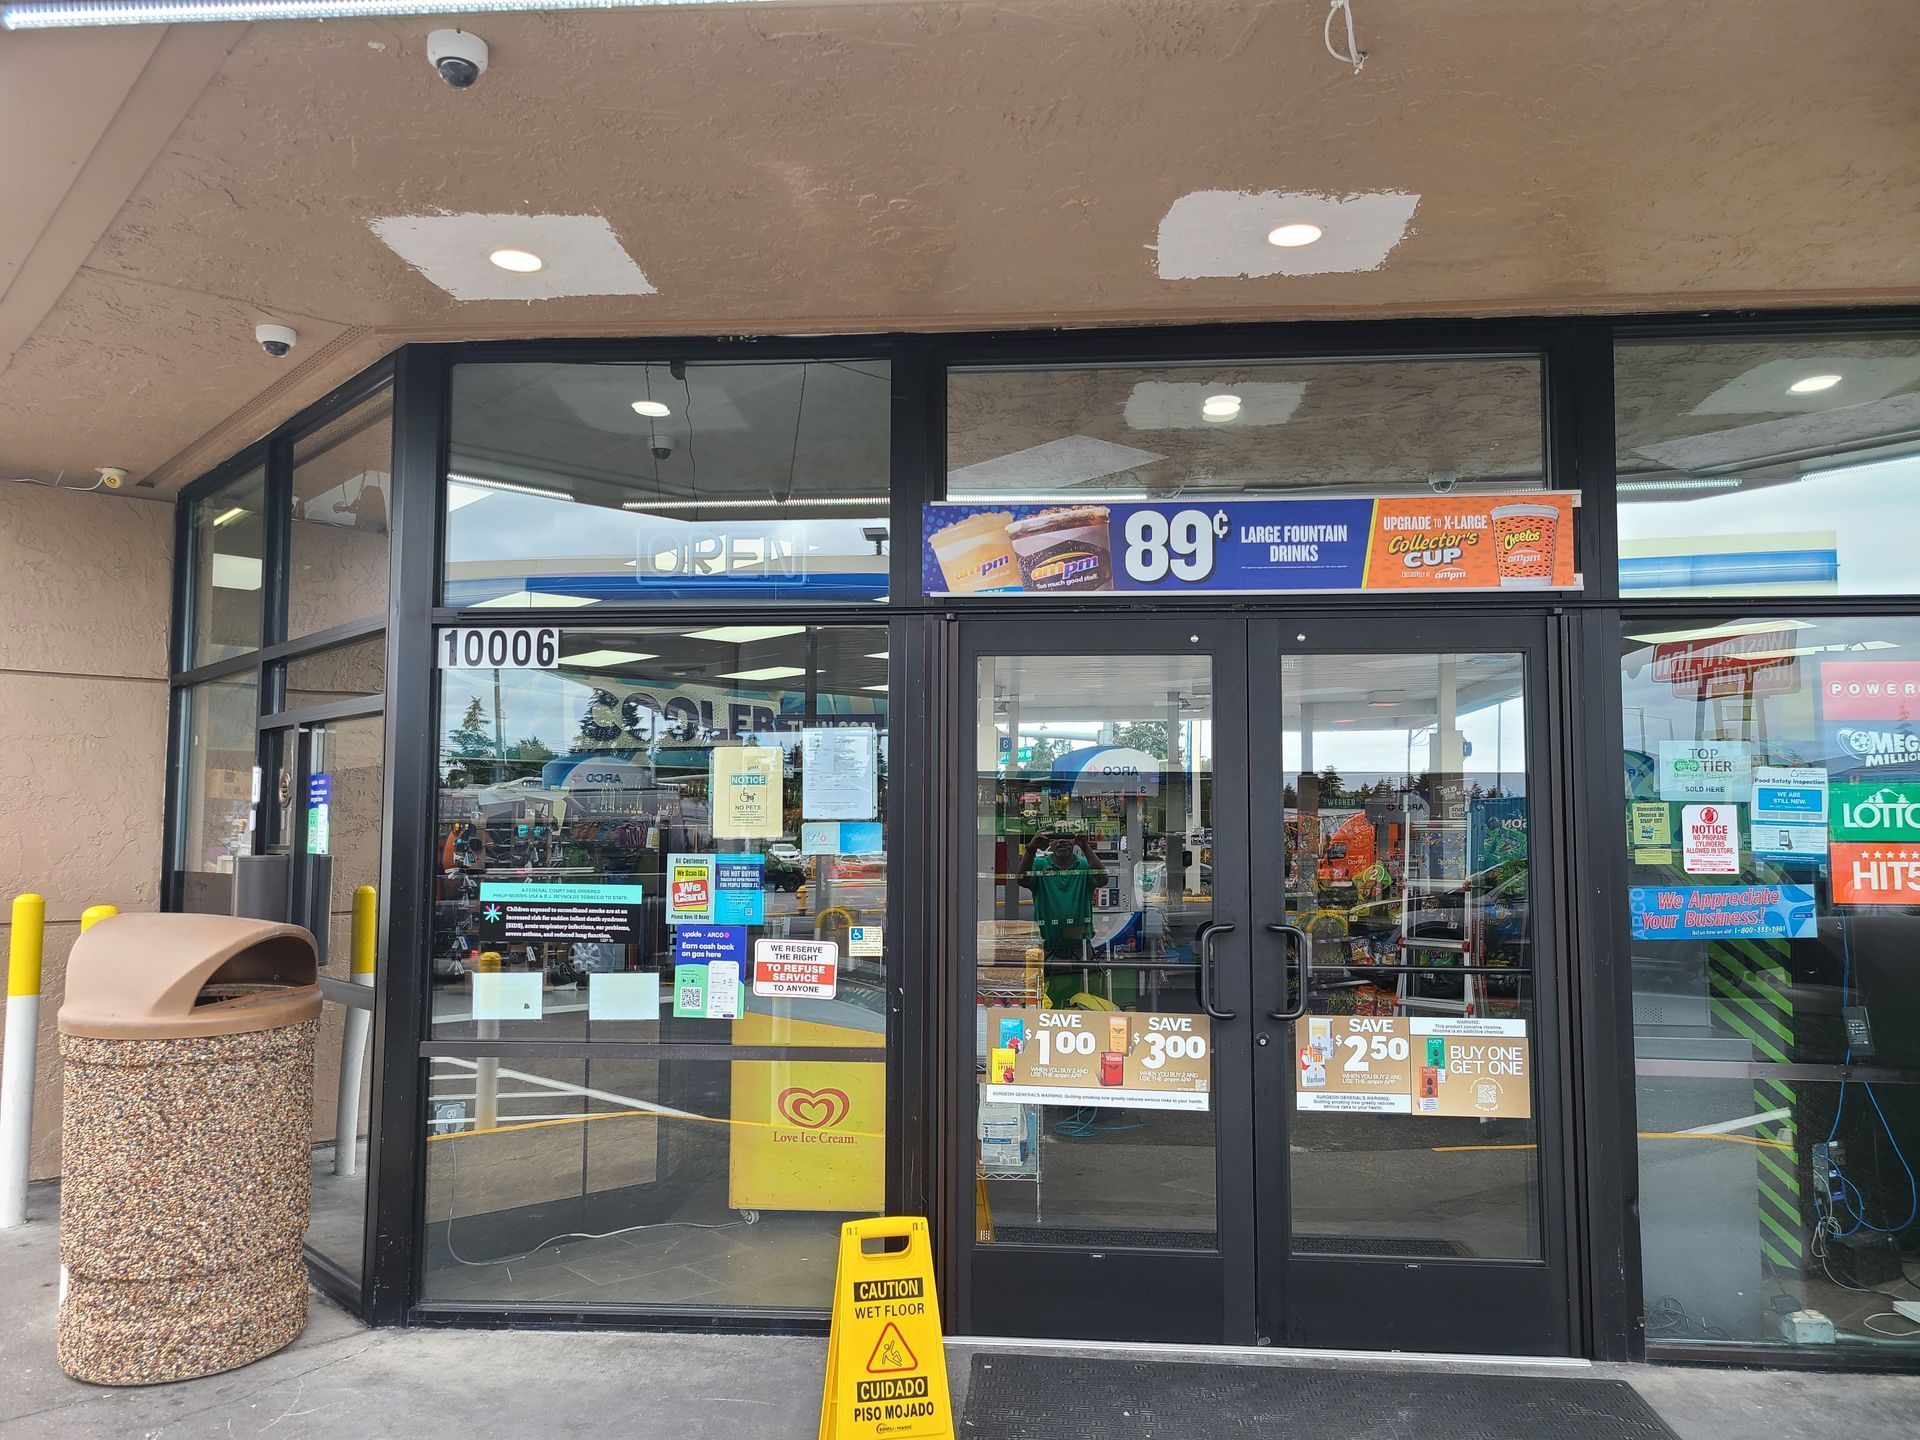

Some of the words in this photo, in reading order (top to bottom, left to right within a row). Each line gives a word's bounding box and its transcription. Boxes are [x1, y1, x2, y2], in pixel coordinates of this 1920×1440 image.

[1383, 515, 1432, 531] UPGRADE
[1433, 518, 1442, 528] TO
[1443, 514, 1488, 530] X-LARGE
[1241, 526, 1281, 544] LARGE
[1284, 524, 1348, 543] FOUNTAIN
[1504, 529, 1541, 550] Cheetos
[1388, 532, 1479, 554] Collector's
[646, 532, 802, 578] OPEN
[1269, 545, 1319, 562] DRINKS
[1403, 548, 1463, 567] CUP
[1031, 555, 1099, 580] ampm
[1435, 568, 1467, 580] ampm
[1036, 582, 1048, 590] Too
[1048, 580, 1066, 589] much
[1066, 576, 1083, 587] good
[443, 628, 556, 667] 10006
[1869, 731, 1920, 754] MEG
[1688, 748, 1719, 760] TOP
[1700, 760, 1732, 772] TIER
[731, 775, 765, 785] NOTICE
[1691, 824, 1728, 835] NOTICE
[677, 869, 685, 877] We
[697, 869, 706, 877] IDs
[720, 870, 730, 878] FOR
[731, 870, 741, 878] NOT
[741, 870, 760, 878] BUYING
[1853, 861, 1920, 891] HIT5
[679, 881, 702, 893] We
[674, 890, 707, 903] Card
[1657, 892, 1684, 910] We
[1688, 888, 1780, 911] Appreciate
[530, 906, 551, 914] exposed
[1641, 912, 1679, 930] Your
[1684, 907, 1766, 929] Business!
[539, 923, 568, 931] respiratory
[568, 923, 595, 931] infections,
[682, 931, 702, 939] upside
[681, 942, 698, 950] Earn
[716, 943, 735, 951] back
[770, 944, 783, 952] WE
[785, 945, 823, 954] RESERVE
[775, 953, 791, 961] THE
[792, 954, 819, 962] RIGHT
[766, 963, 781, 972] TO
[783, 964, 826, 974] REFUSE
[772, 973, 819, 983] SERVICE
[773, 984, 784, 992] TO
[786, 985, 820, 993] ANYONE
[1038, 1013, 1082, 1028] SAVE
[1148, 1016, 1193, 1032] SAVE
[1348, 1018, 1394, 1034] SAVE
[1450, 1045, 1486, 1060] BUY
[1487, 1046, 1523, 1061] ONE
[1450, 1060, 1485, 1074] GET
[1488, 1061, 1524, 1076] ONE
[773, 1131, 799, 1143] Love
[800, 1131, 817, 1143] Ice
[818, 1132, 855, 1144] Cream
[859, 1279, 919, 1300] CAUTION
[854, 1304, 881, 1319] WET
[884, 1302, 925, 1317] FLOOR
[860, 1377, 926, 1400] CUIDADO
[854, 1404, 881, 1422] PISO
[885, 1401, 935, 1420] MOJADO
